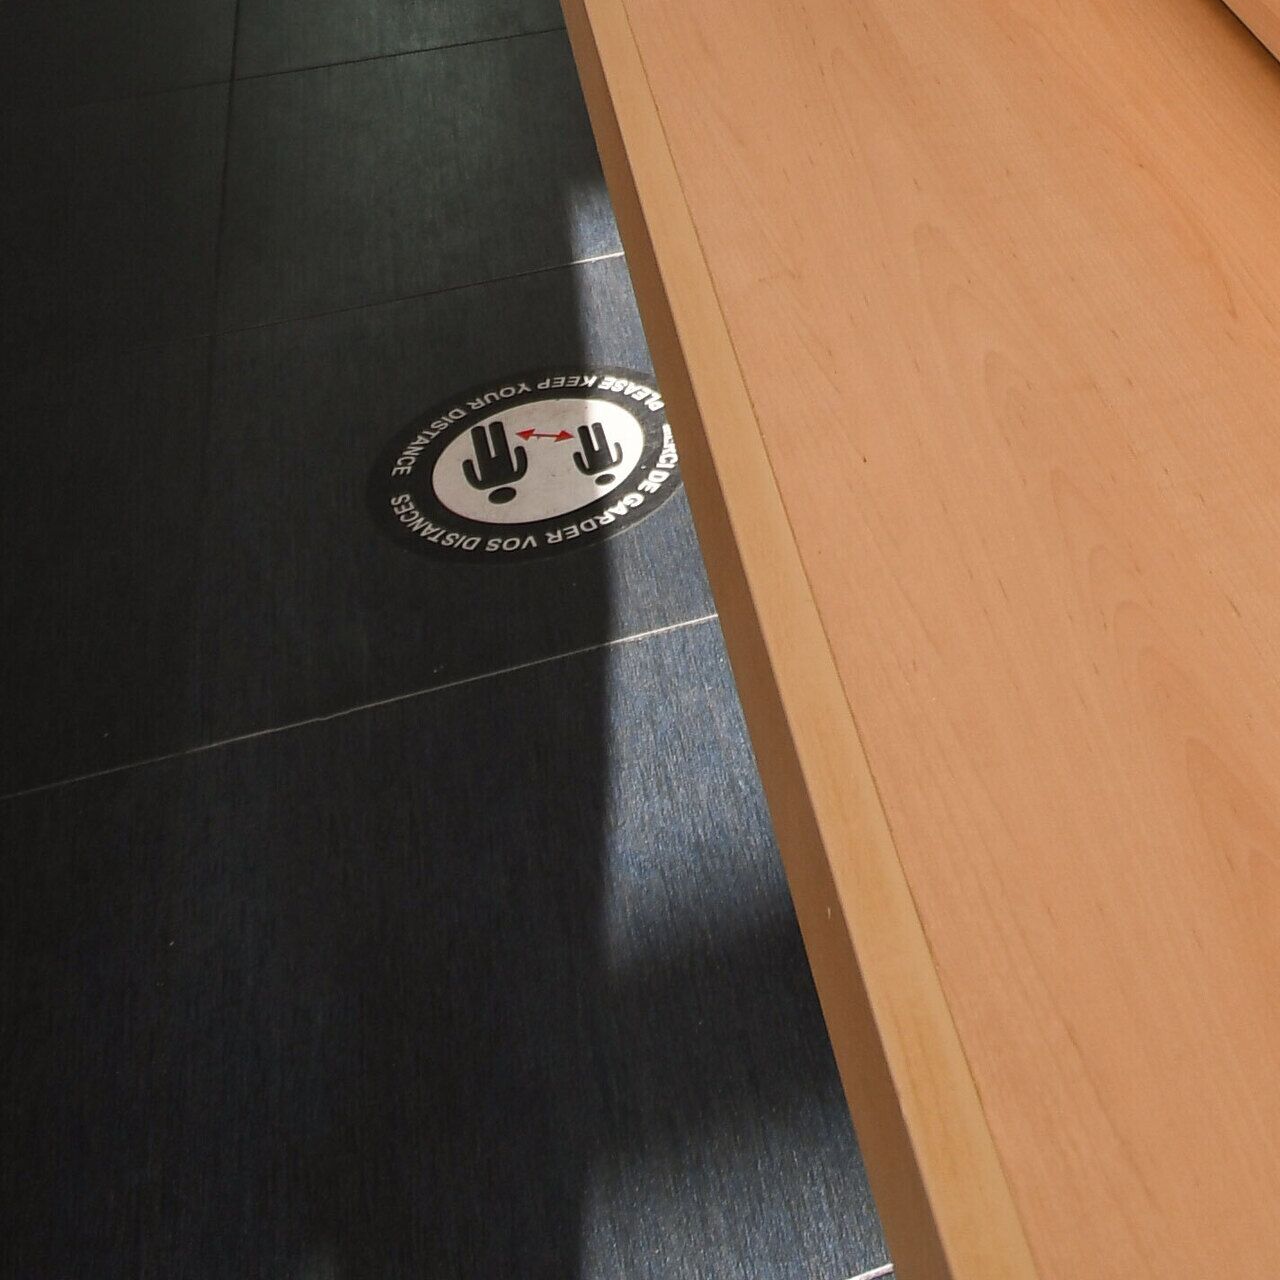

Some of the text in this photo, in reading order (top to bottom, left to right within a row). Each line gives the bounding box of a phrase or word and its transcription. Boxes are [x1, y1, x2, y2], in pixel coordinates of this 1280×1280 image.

[391, 375, 666, 477] PLEASE KEEP YOUR DISTANCE
[637, 469, 670, 495] DE
[390, 493, 481, 552] DISTANCES
[485, 535, 538, 552] VOS
[546, 492, 645, 545] GARDER
